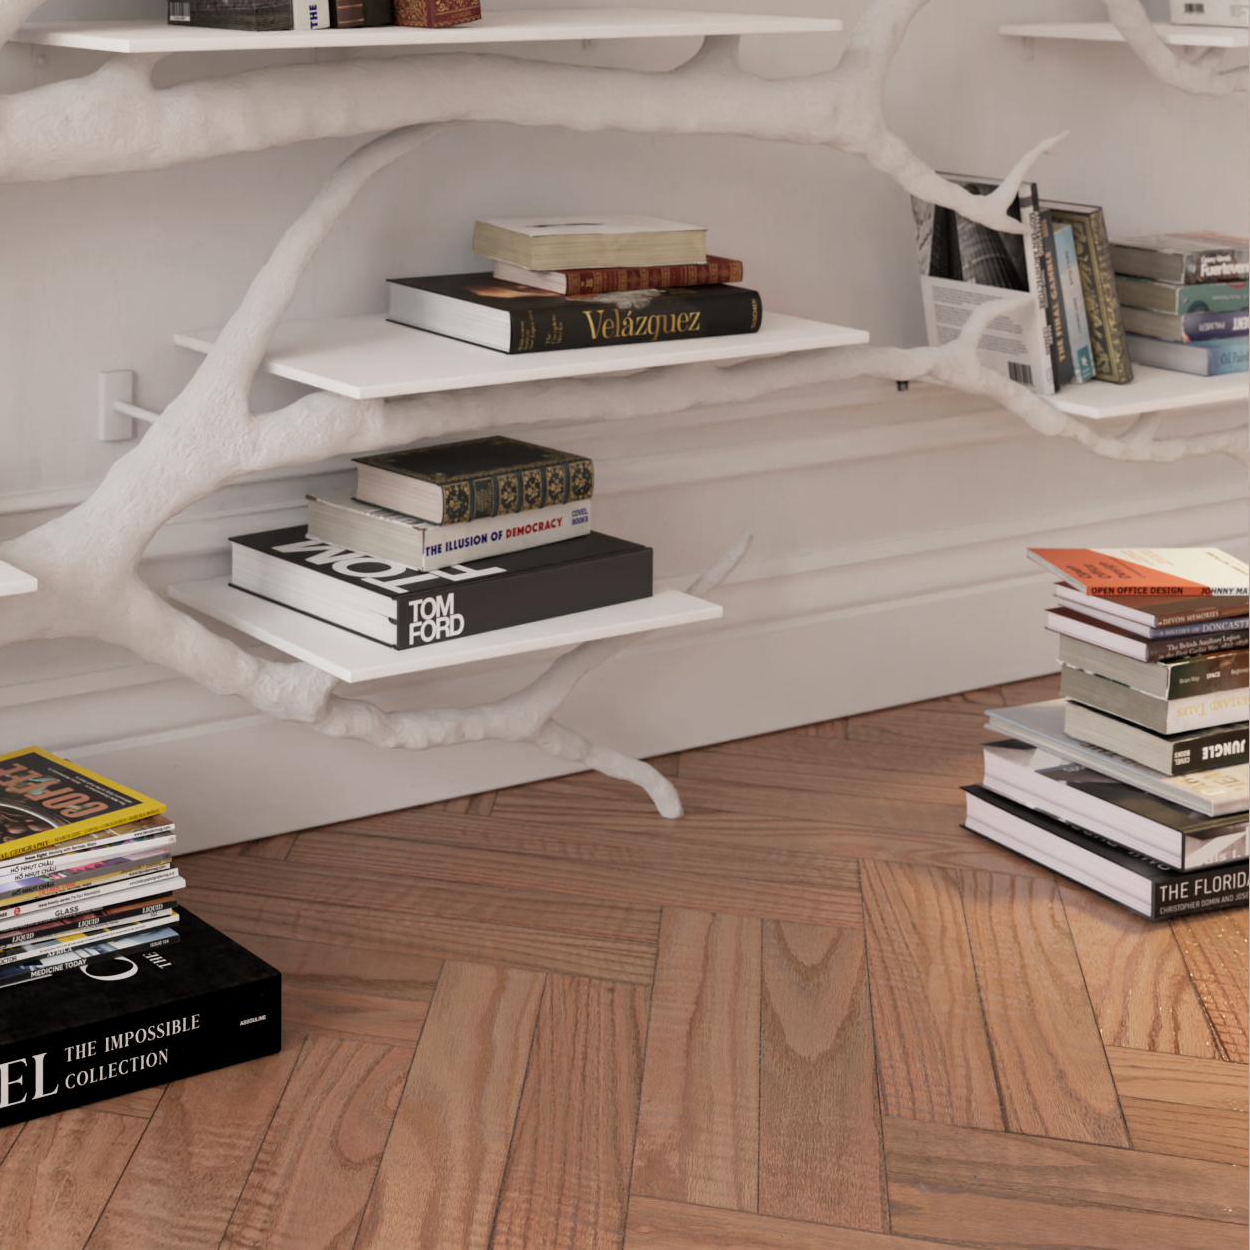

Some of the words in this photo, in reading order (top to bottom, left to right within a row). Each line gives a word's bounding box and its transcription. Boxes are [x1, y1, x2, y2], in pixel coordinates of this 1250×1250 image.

[309, 4, 318, 29] THE
[1045, 251, 1058, 300] GAMBLE
[583, 308, 700, 341] Velázquez
[1052, 301, 1064, 337] FINAL
[1057, 339, 1066, 363] THE
[572, 508, 588, 516] COVEL
[572, 516, 589, 525] BOOKS
[426, 544, 442, 557] THE
[445, 533, 488, 552] ILLUSION
[491, 530, 503, 541] OF
[506, 517, 563, 539] DEMOCRACY
[1201, 587, 1234, 595] JOHNNY
[408, 593, 455, 623] TOM
[1163, 617, 1185, 625] DEVON
[1187, 611, 1219, 621] MEMORIES
[408, 614, 465, 646] FORD
[1165, 627, 1190, 635] HISTORY
[1179, 640, 1197, 649] British
[1199, 637, 1222, 646] Auxiliary
[1223, 634, 1240, 642] Legion
[1206, 671, 1220, 679] SPACE
[1175, 750, 1190, 758] BOOKS
[1202, 739, 1246, 760] JUNGLE
[10, 841, 49, 856] GEOGRAPHY
[1160, 882, 1189, 902] THE
[55, 906, 79, 917] GLASS
[142, 904, 163, 913] LIQUID
[1160, 900, 1199, 915] CHRISTOPHER
[1201, 896, 1220, 907] DOMIN
[1221, 894, 1234, 903] AND
[78, 918, 99, 927] LIQUID
[12, 932, 34, 942] LIQUID
[31, 965, 64, 978] MEDICINE
[65, 958, 87, 969] TODAY
[142, 952, 172, 969] THE
[240, 1014, 267, 1027] ASSOULINE
[64, 1040, 97, 1062] THE
[104, 1013, 201, 1053] IMPOSSIBLE
[64, 1048, 169, 1090] COLLECTION
